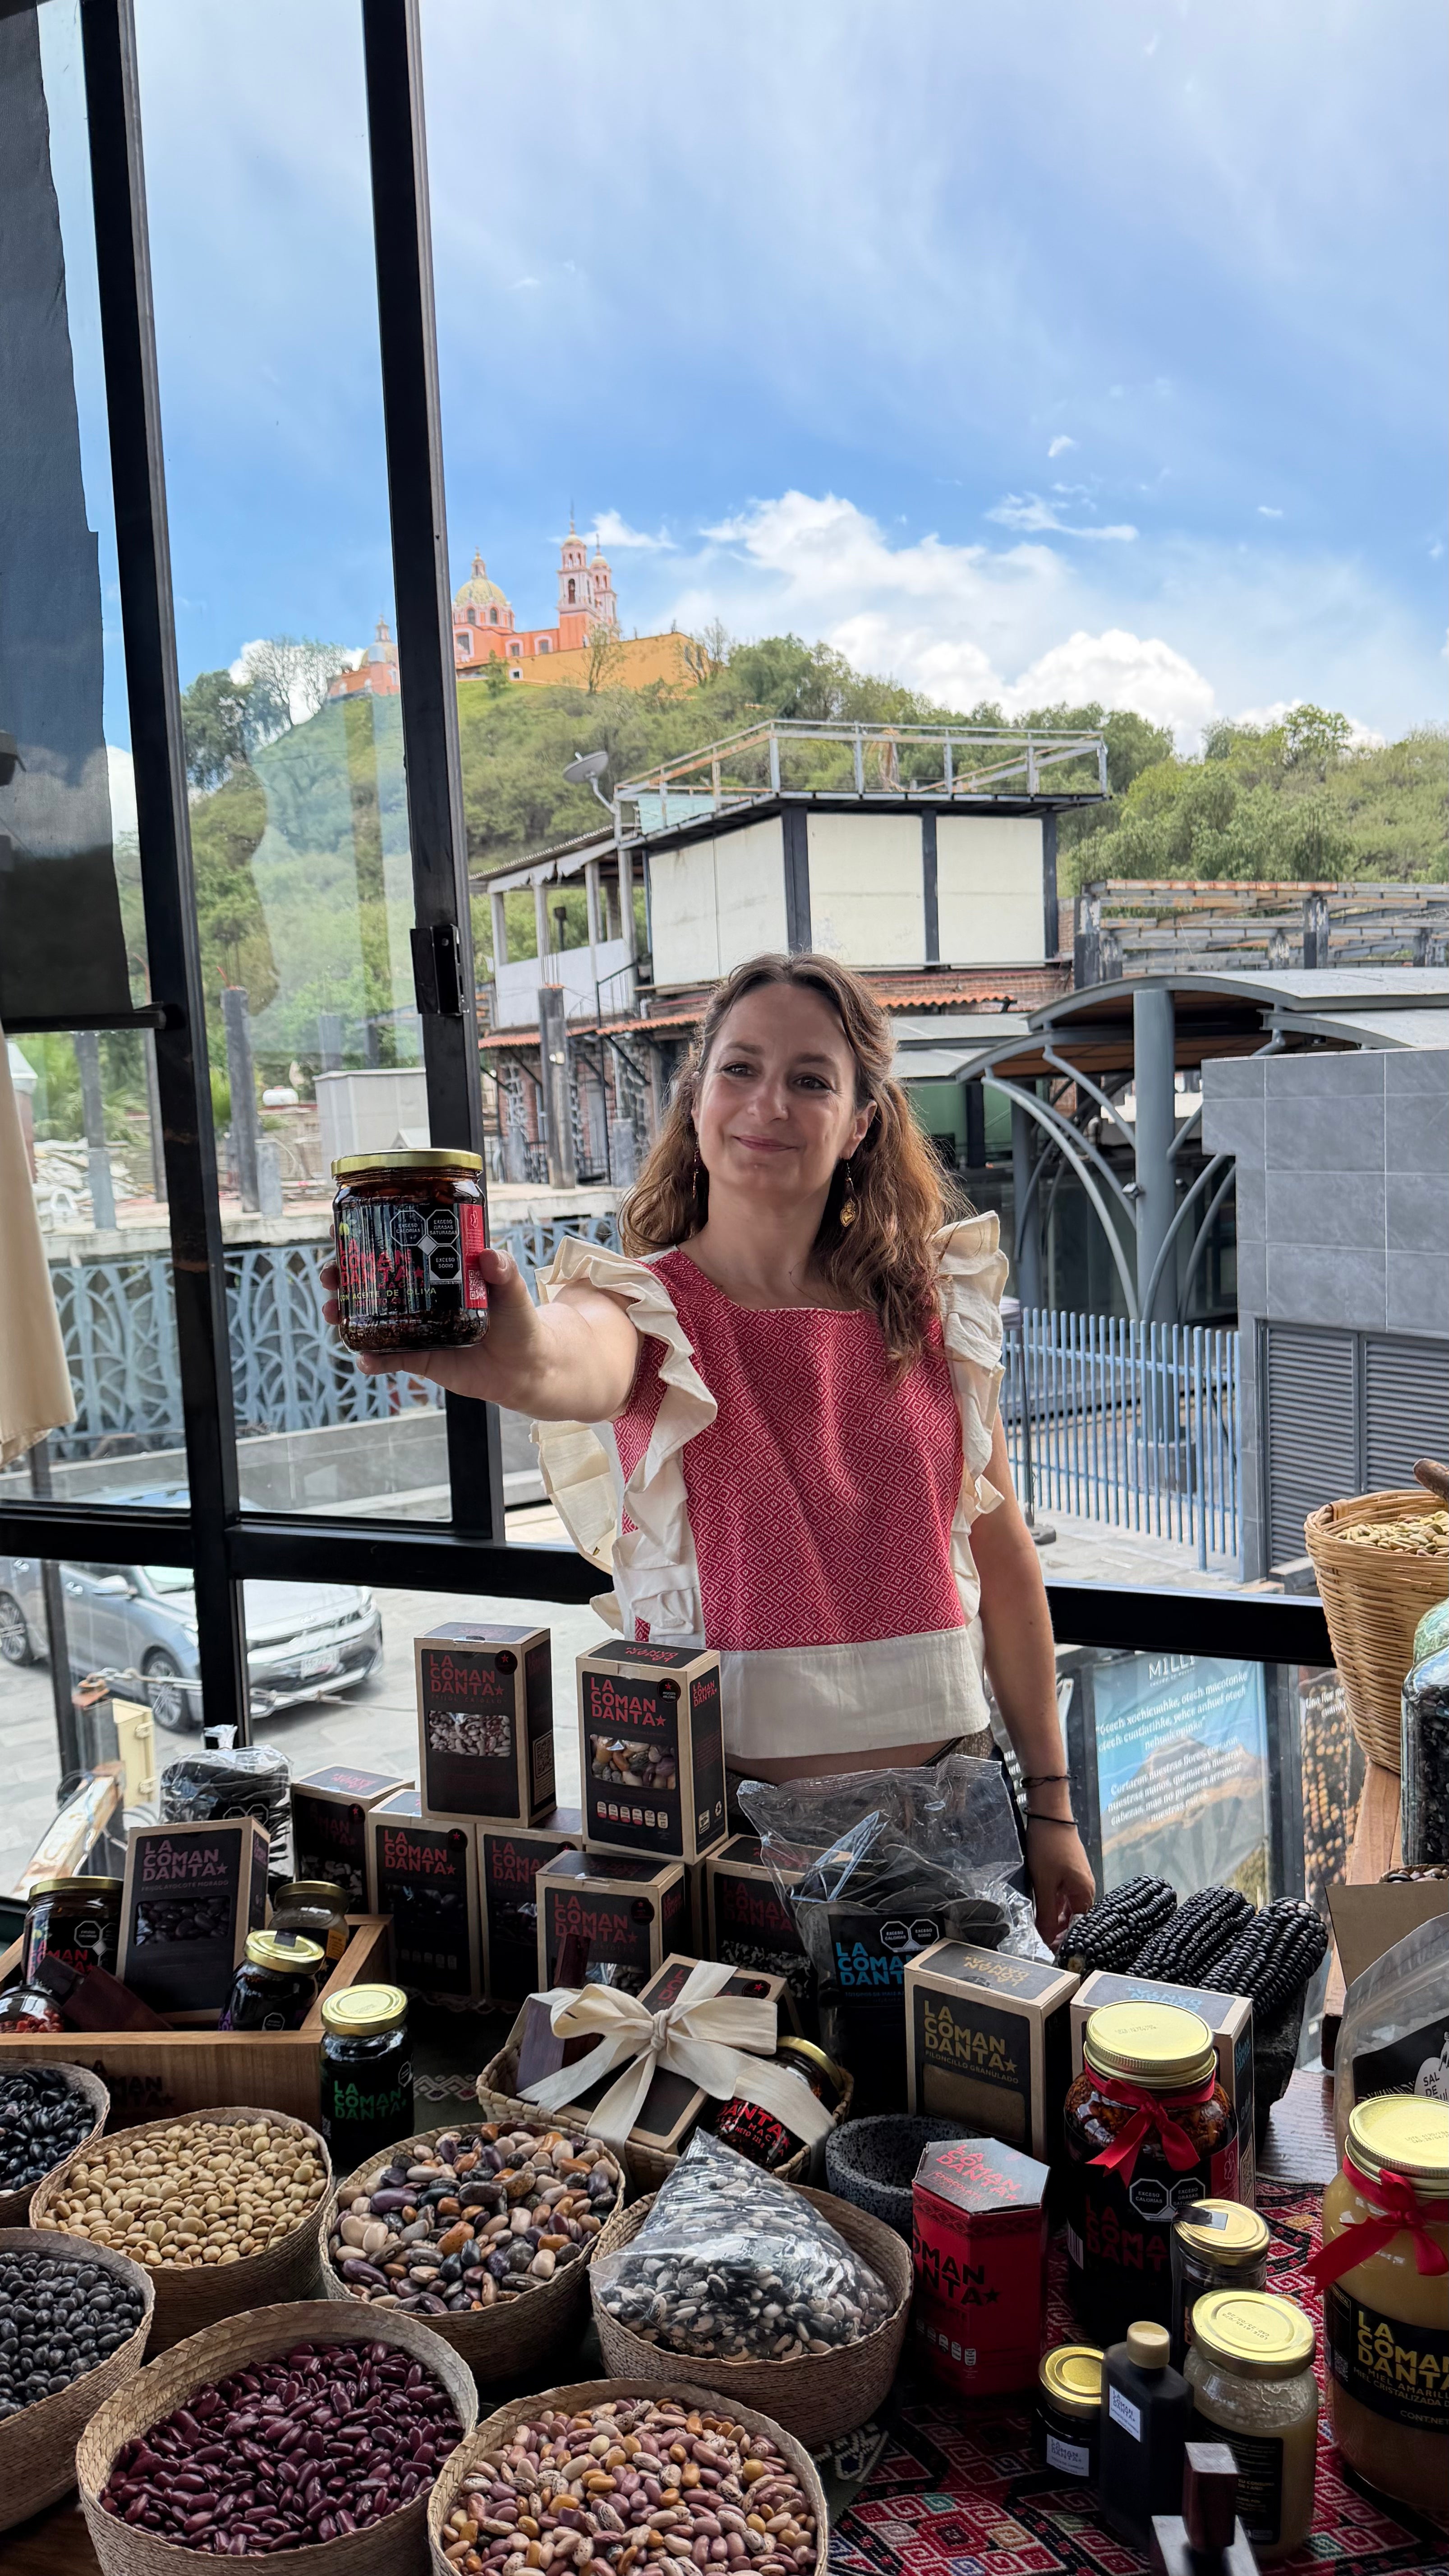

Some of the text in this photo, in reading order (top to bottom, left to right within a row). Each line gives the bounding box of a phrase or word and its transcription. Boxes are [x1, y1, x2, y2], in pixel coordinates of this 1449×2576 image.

[407, 1287, 437, 1295] OLIVA
[430, 1654, 453, 1668] LA
[430, 1667, 495, 1684] COMAN
[590, 1677, 614, 1693] LA
[430, 1679, 495, 1696] DANTA
[591, 1691, 656, 1713] COMAN
[592, 1704, 656, 1727] DANTA
[384, 1830, 408, 1844] LA
[145, 1840, 173, 1854] LA
[384, 1843, 447, 1863] COMAN
[492, 1840, 515, 1855] LA
[143, 1849, 219, 1868] COMAN
[385, 1856, 448, 1876] DANTA
[492, 1852, 546, 1873] COMA
[143, 1863, 217, 1882] DANTA
[493, 1865, 536, 1883] DAN
[722, 1880, 748, 1896] LA
[554, 1894, 581, 1910] LA
[554, 1908, 628, 1930] COMAN
[836, 1942, 868, 1957] LA
[840, 1970, 904, 1985] DANT
[925, 2000, 954, 2024] LA
[925, 2017, 1005, 2055] COMAN
[925, 2032, 1005, 2071] DANTA
[925, 2049, 1018, 2084] PILONCILLO GRANULADO
[334, 2079, 359, 2096] LA
[1423, 2072, 1440, 2087] SAL
[334, 2086, 401, 2108] COMAN
[1426, 2085, 1438, 2097] DE
[335, 2100, 400, 2121] DANTA
[957, 2144, 984, 2162] LA
[936, 2154, 1007, 2197] DANTA
[948, 2150, 1021, 2191] COMAN
[1085, 2194, 1119, 2227] LA
[1085, 2215, 1168, 2254] COMA
[912, 2235, 985, 2285] OMAN
[1086, 2237, 1169, 2272] DANT
[1358, 2310, 1394, 2344] LA
[1354, 2367, 1371, 2383] MIEL
[1373, 2380, 1441, 2406] CRISTALIZADA
[1368, 2369, 1393, 2386] MIEL
